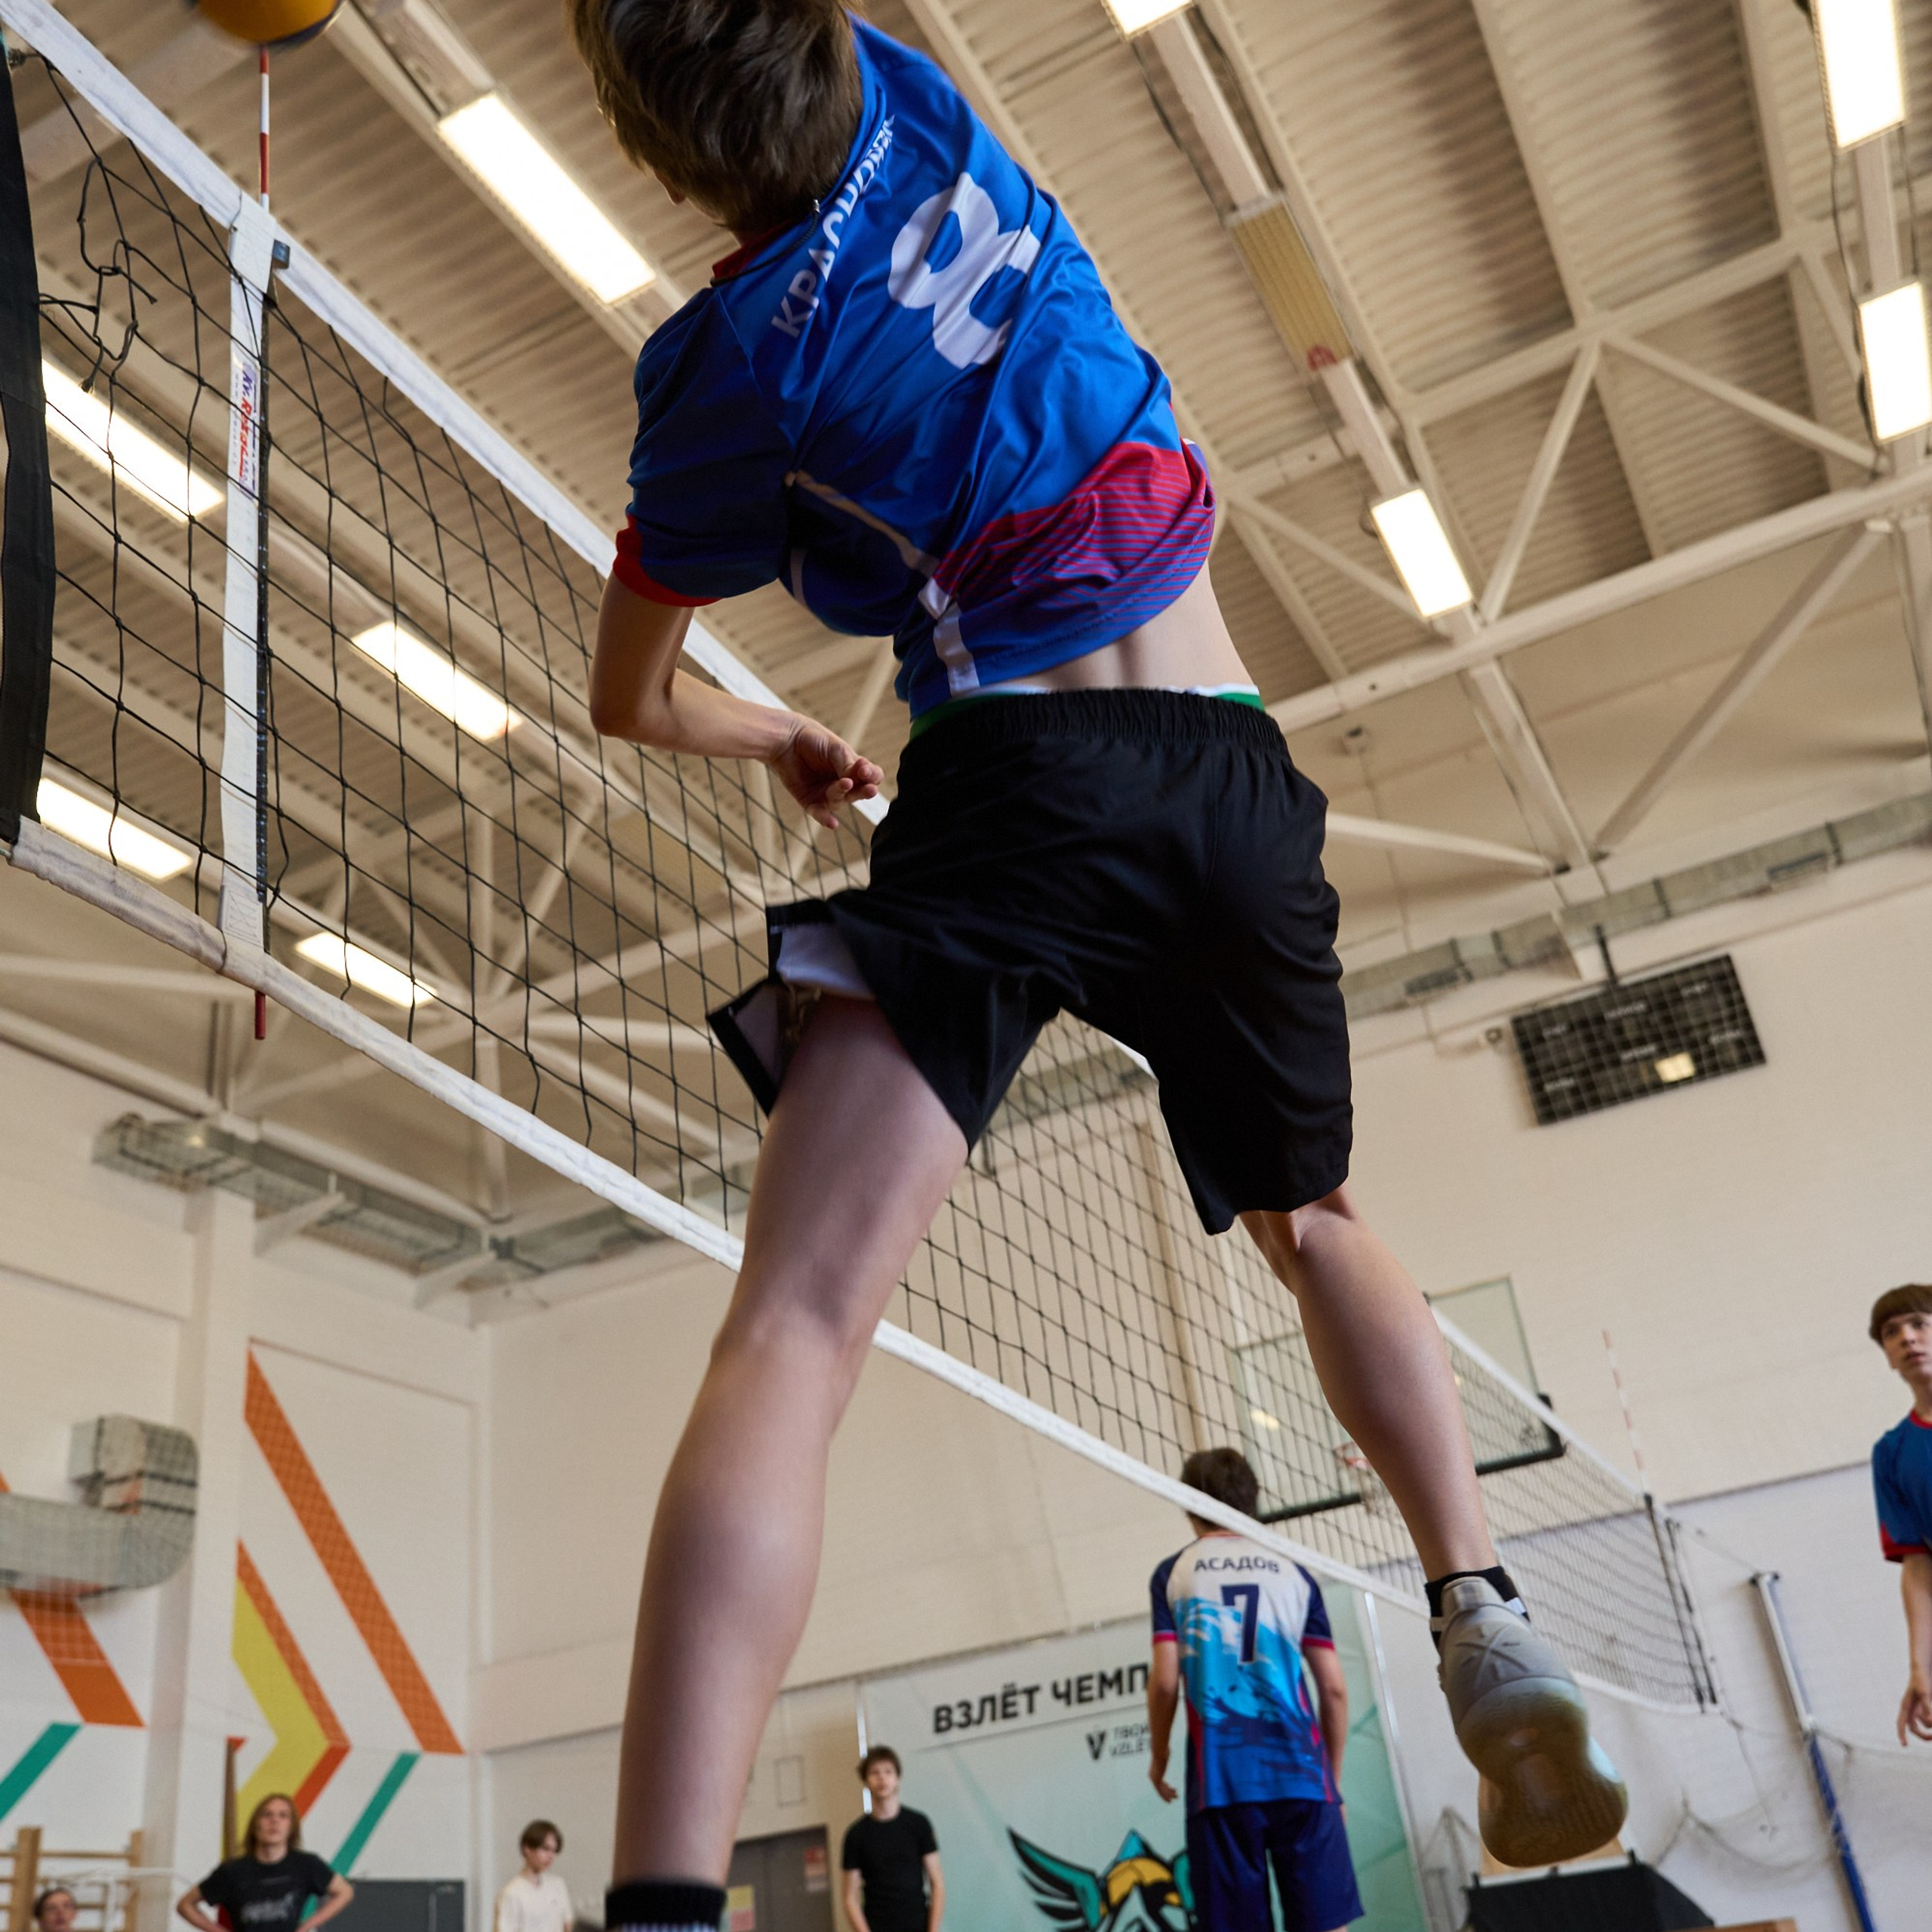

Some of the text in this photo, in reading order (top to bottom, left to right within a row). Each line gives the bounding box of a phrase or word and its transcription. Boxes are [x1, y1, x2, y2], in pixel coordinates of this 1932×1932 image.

[888, 172, 1041, 370] 8
[1195, 1556, 1279, 1573] АСАДОВ
[1221, 1583, 1260, 1662] 7
[934, 1683, 1041, 1734] ВЗЛЁТ
